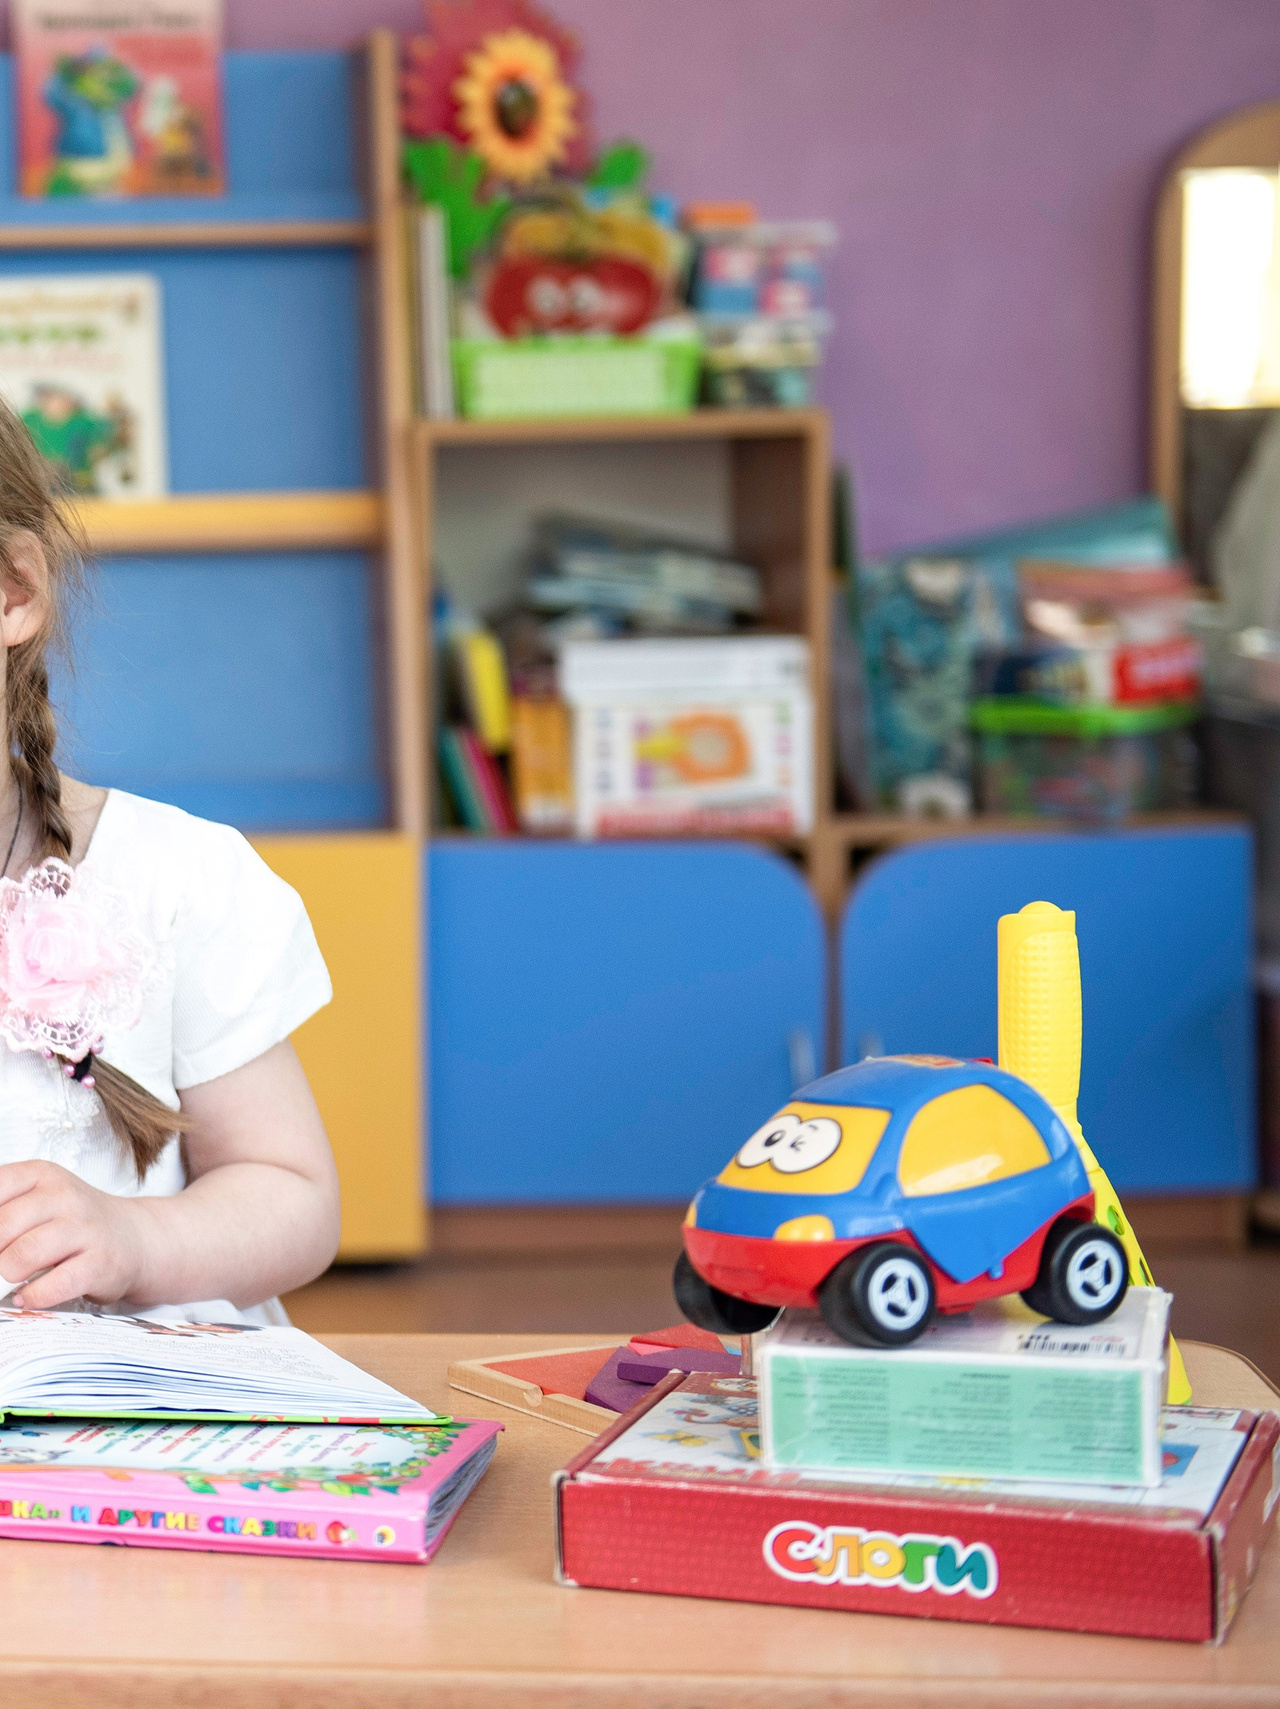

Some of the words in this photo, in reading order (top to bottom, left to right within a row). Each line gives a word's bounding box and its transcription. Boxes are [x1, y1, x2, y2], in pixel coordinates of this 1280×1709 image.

[71, 1505, 91, 1523] И
[98, 1507, 200, 1531] ДРУГИЕ
[207, 1515, 318, 1540] СКАЗКИ
